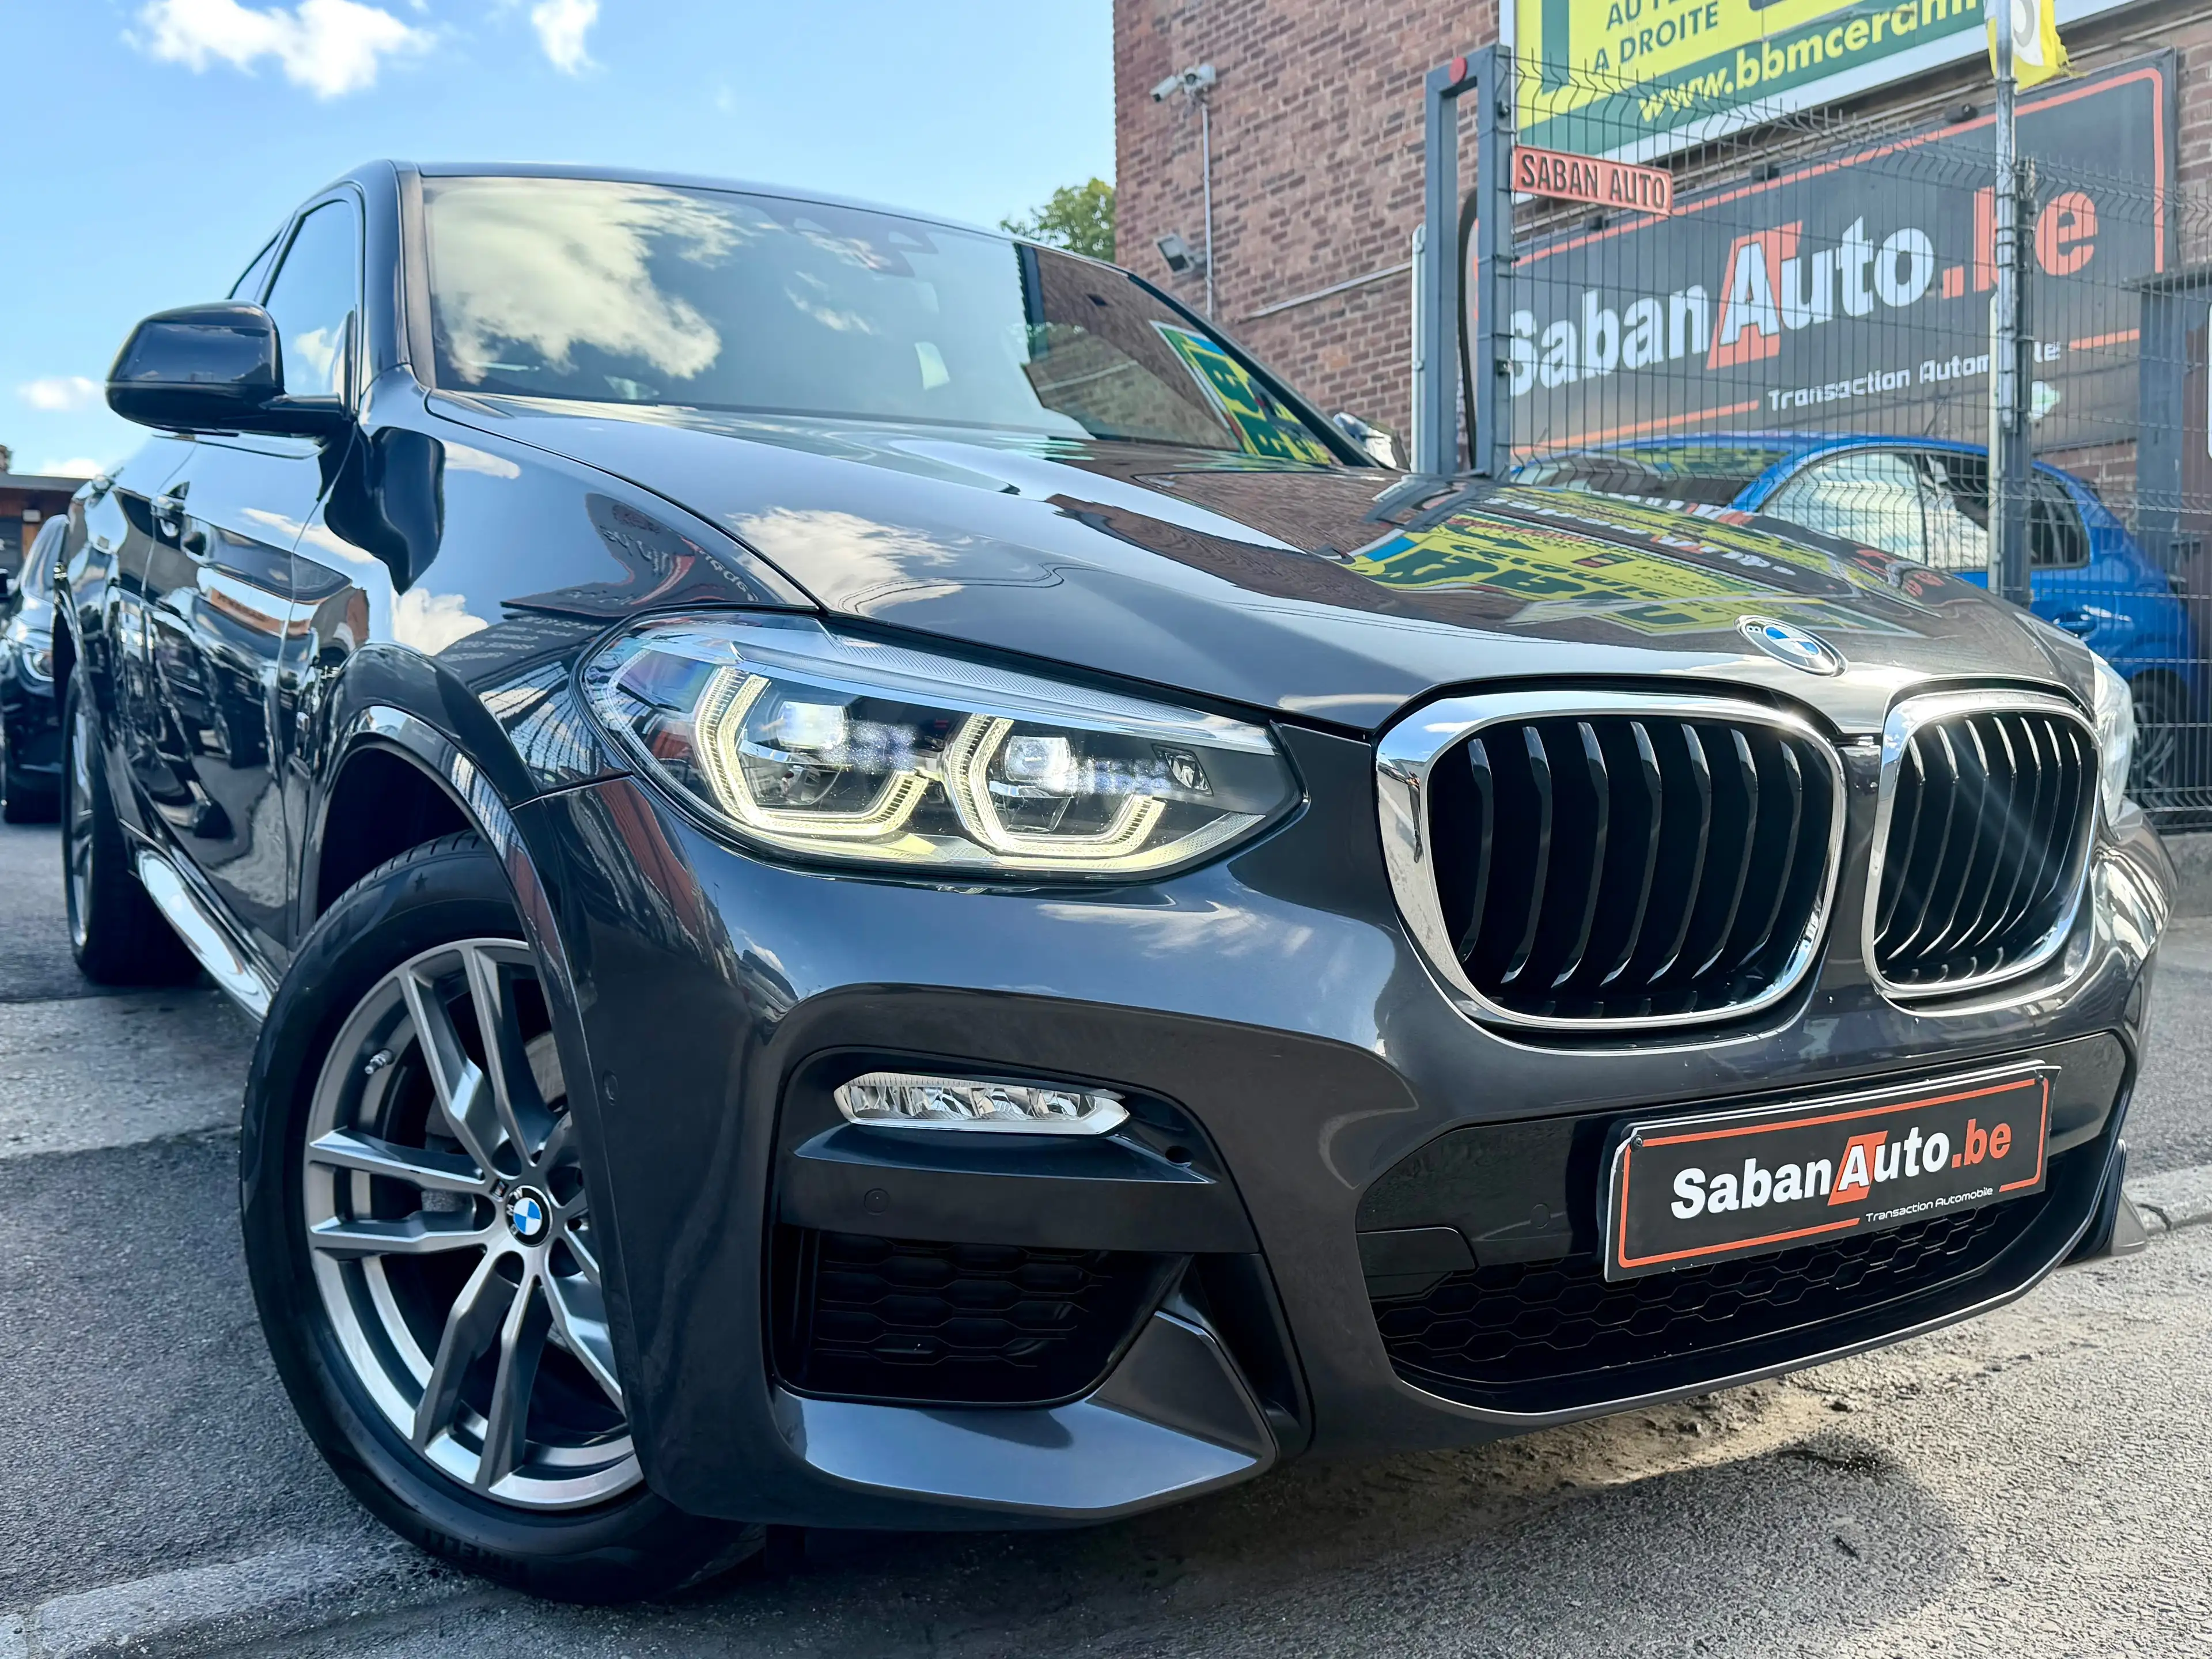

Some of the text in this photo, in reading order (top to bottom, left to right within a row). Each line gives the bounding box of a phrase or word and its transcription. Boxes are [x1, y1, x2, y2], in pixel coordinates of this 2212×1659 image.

[1592, 1, 1718, 73] A DROITE
[1605, 0, 1641, 31] AU
[1638, 0, 1976, 122] www.bbmceram
[1521, 154, 1665, 209] SABAN AUTO
[1768, 341, 2061, 411] Transaction Automle
[1671, 1118, 2012, 1219] SabanAuto.be
[1865, 1185, 1994, 1222] Transaction Automobile
